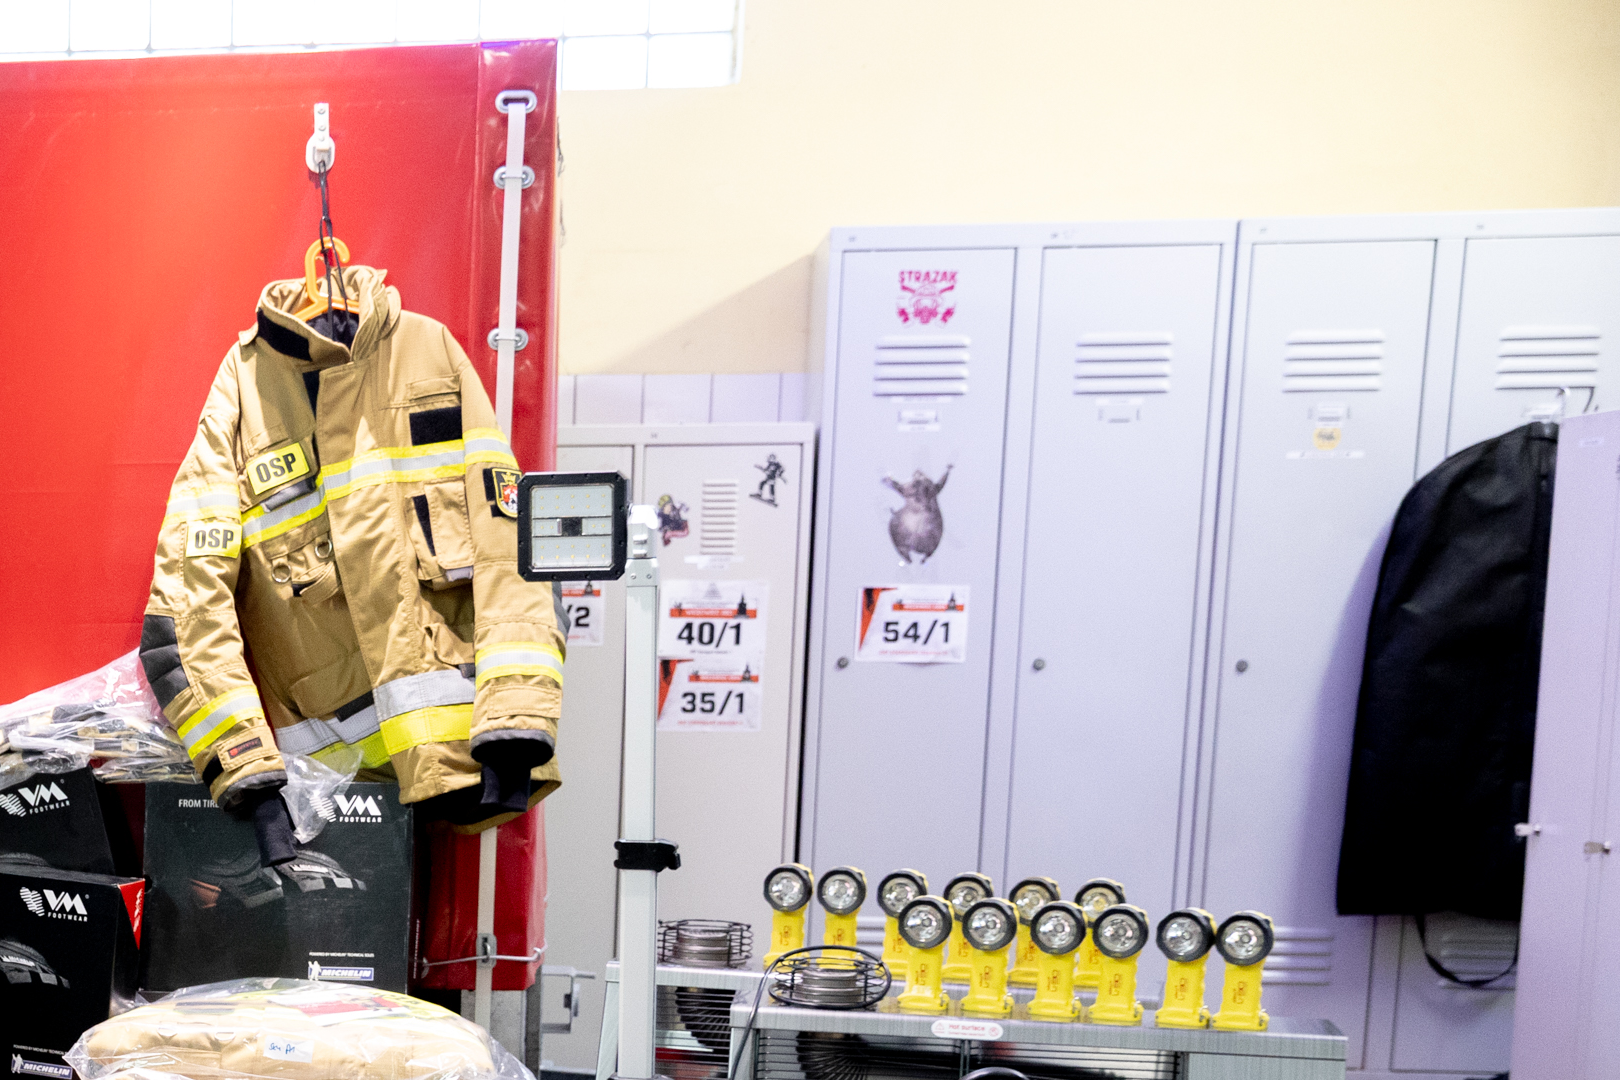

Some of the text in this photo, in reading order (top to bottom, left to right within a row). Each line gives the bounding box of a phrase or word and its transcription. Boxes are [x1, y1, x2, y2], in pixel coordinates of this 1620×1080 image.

[255, 452, 296, 483] OSP
[194, 528, 234, 549] OSP
[677, 621, 742, 648] 40/1
[883, 620, 951, 645] 54/1
[680, 690, 744, 716] 35/1
[18, 781, 68, 807] VM
[178, 798, 219, 808] FROM TIR
[333, 794, 382, 816] VM
[29, 800, 70, 814] FOOTWEAR
[43, 889, 88, 915] VM
[47, 911, 88, 923] FOOTWEAR
[321, 969, 371, 977] MICHELIN
[23, 1063, 70, 1076] MICHELIN
